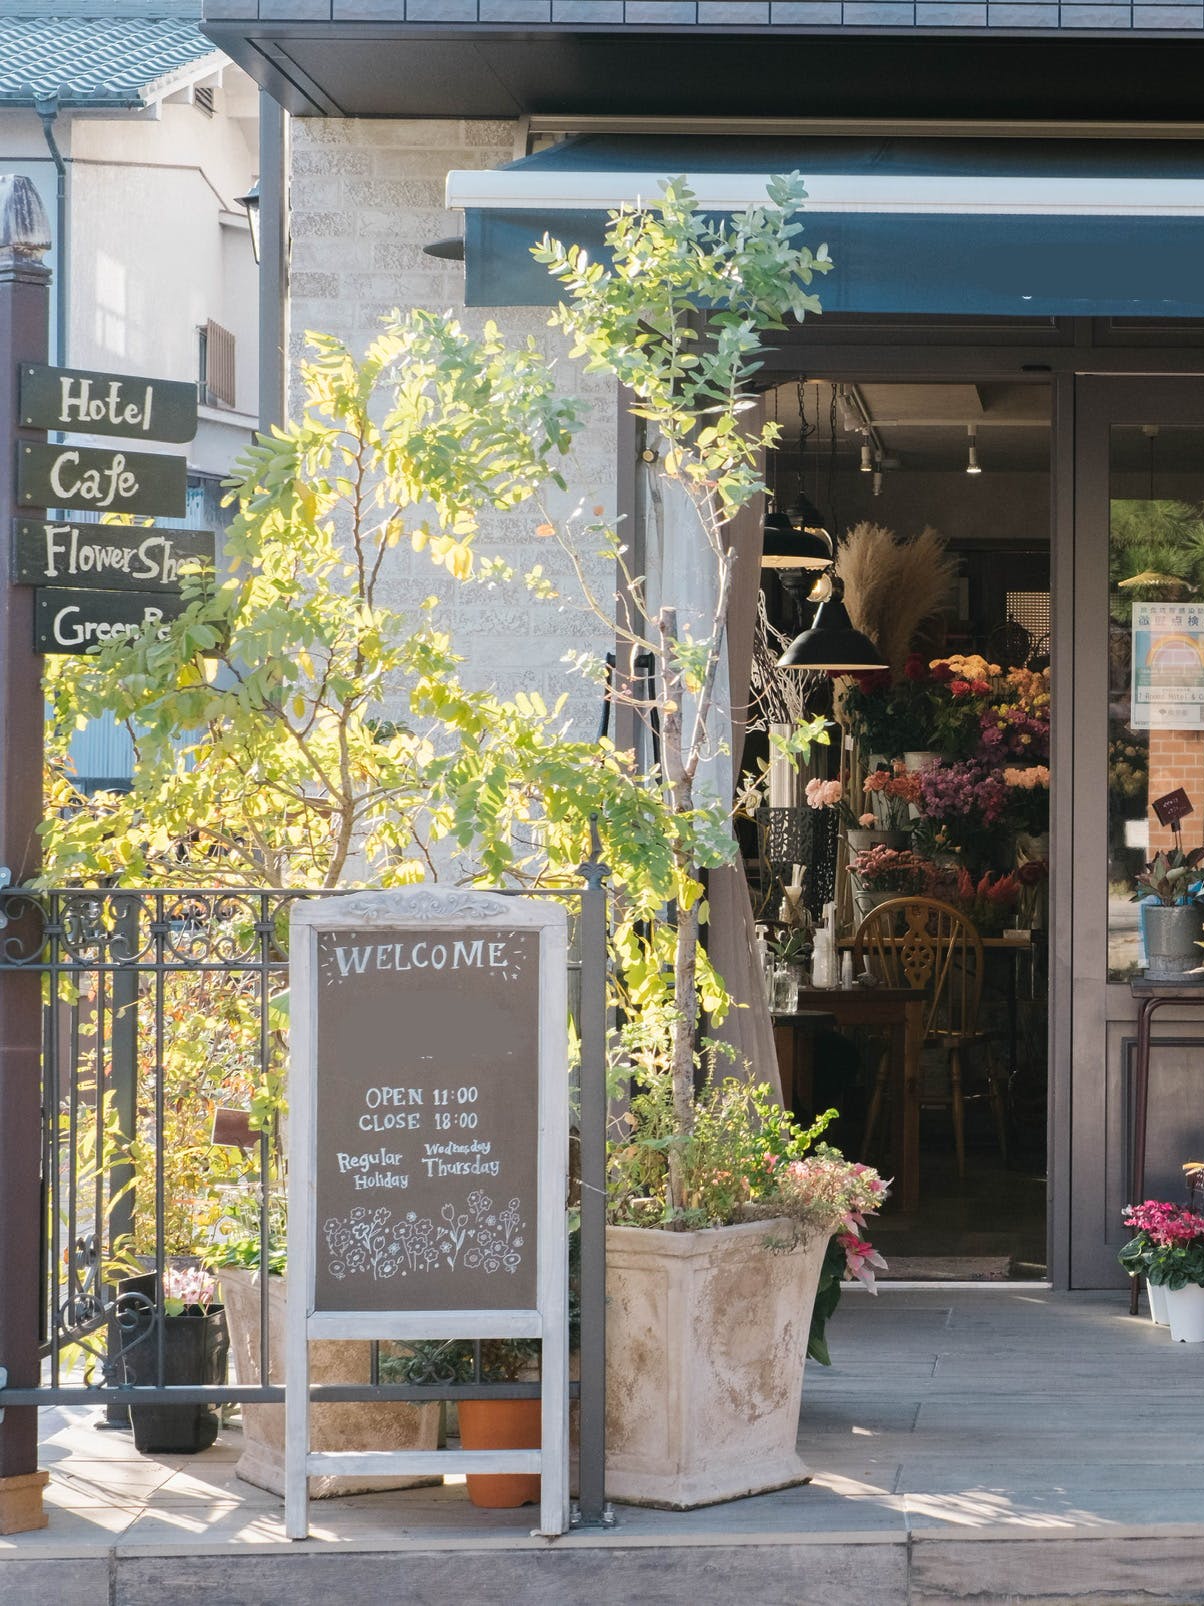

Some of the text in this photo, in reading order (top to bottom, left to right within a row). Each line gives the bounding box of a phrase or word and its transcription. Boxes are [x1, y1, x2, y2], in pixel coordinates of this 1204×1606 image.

[58, 376, 153, 431] Hotel
[50, 451, 139, 506] Cafe
[53, 606, 140, 646] Green
[334, 940, 509, 977] WELCOME
[366, 1086, 478, 1108] OPEN 11:00
[359, 1112, 478, 1132] CLOSE 18:00
[424, 1139, 491, 1156] Wednesday
[336, 1147, 403, 1173] Regular
[421, 1154, 500, 1177] Thursday
[354, 1172, 409, 1190] Holiday
